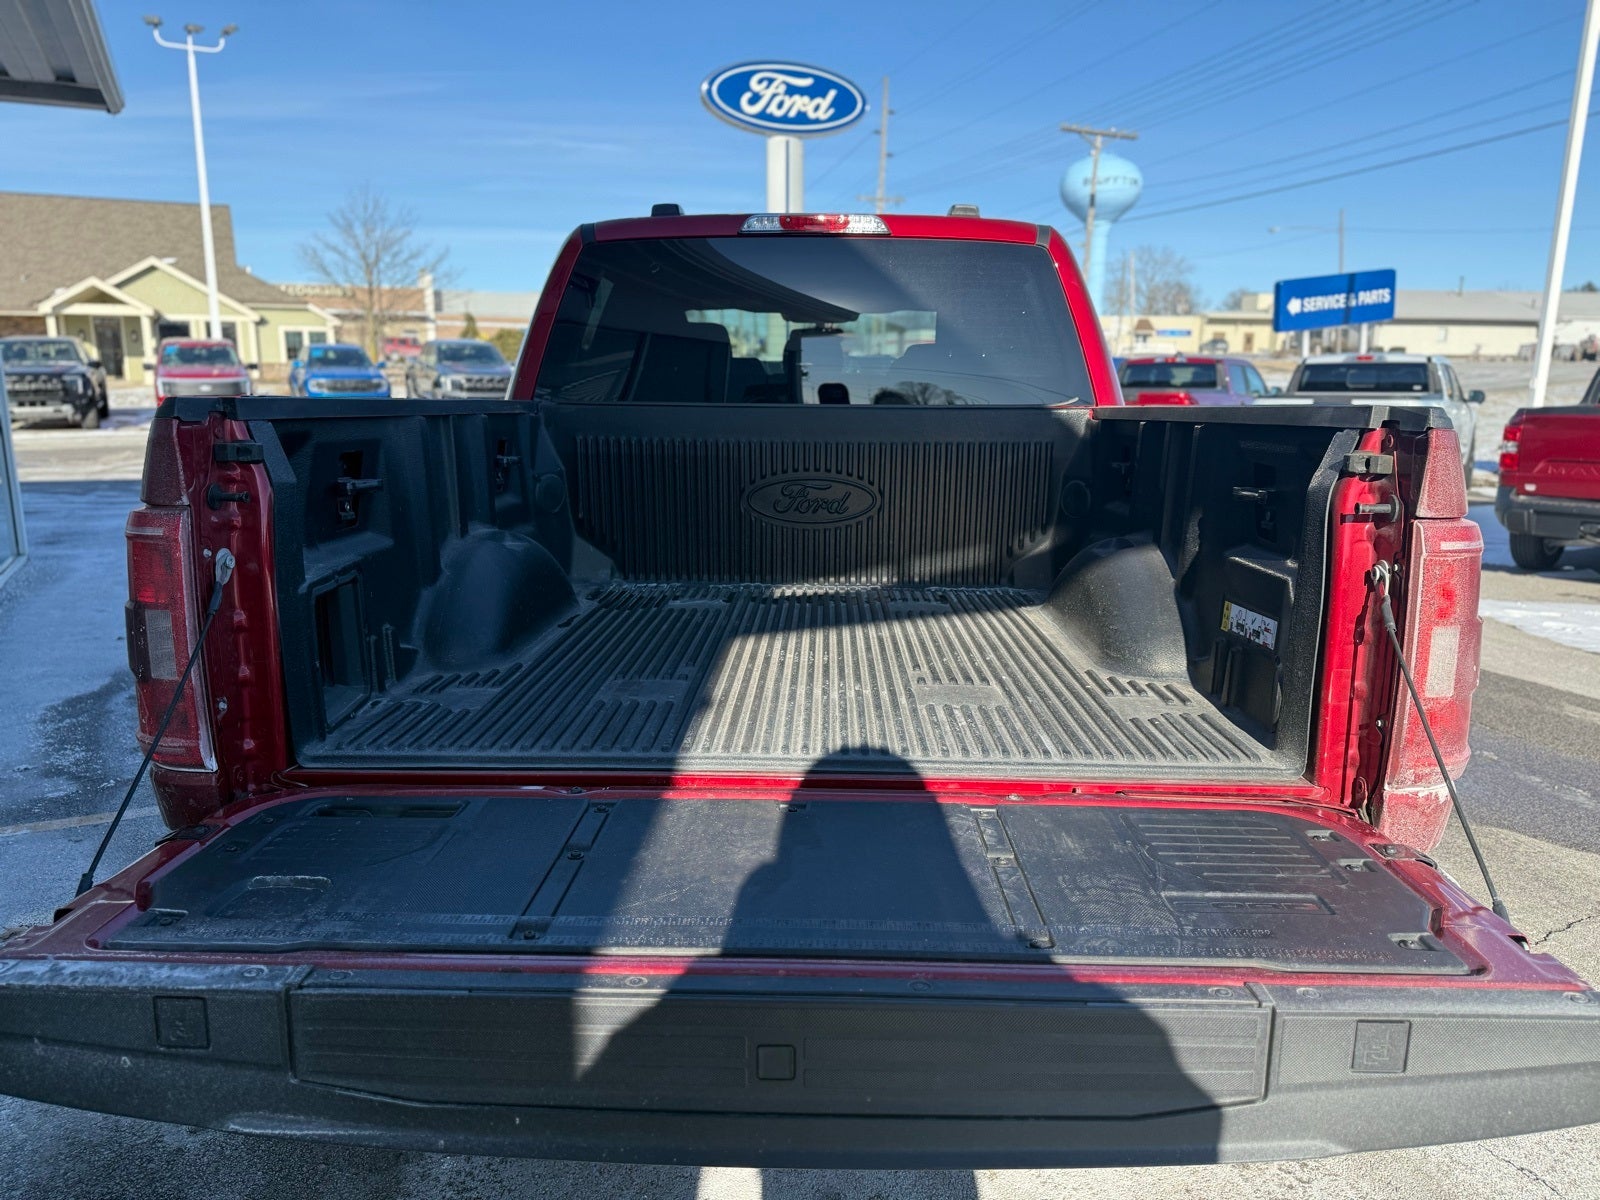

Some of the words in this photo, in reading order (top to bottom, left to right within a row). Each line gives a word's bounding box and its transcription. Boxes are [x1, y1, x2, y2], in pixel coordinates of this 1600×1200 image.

[739, 71, 838, 120] Ford
[1302, 293, 1347, 312] SERVICE
[1358, 288, 1391, 306] PARTS
[774, 483, 851, 515] Ford
